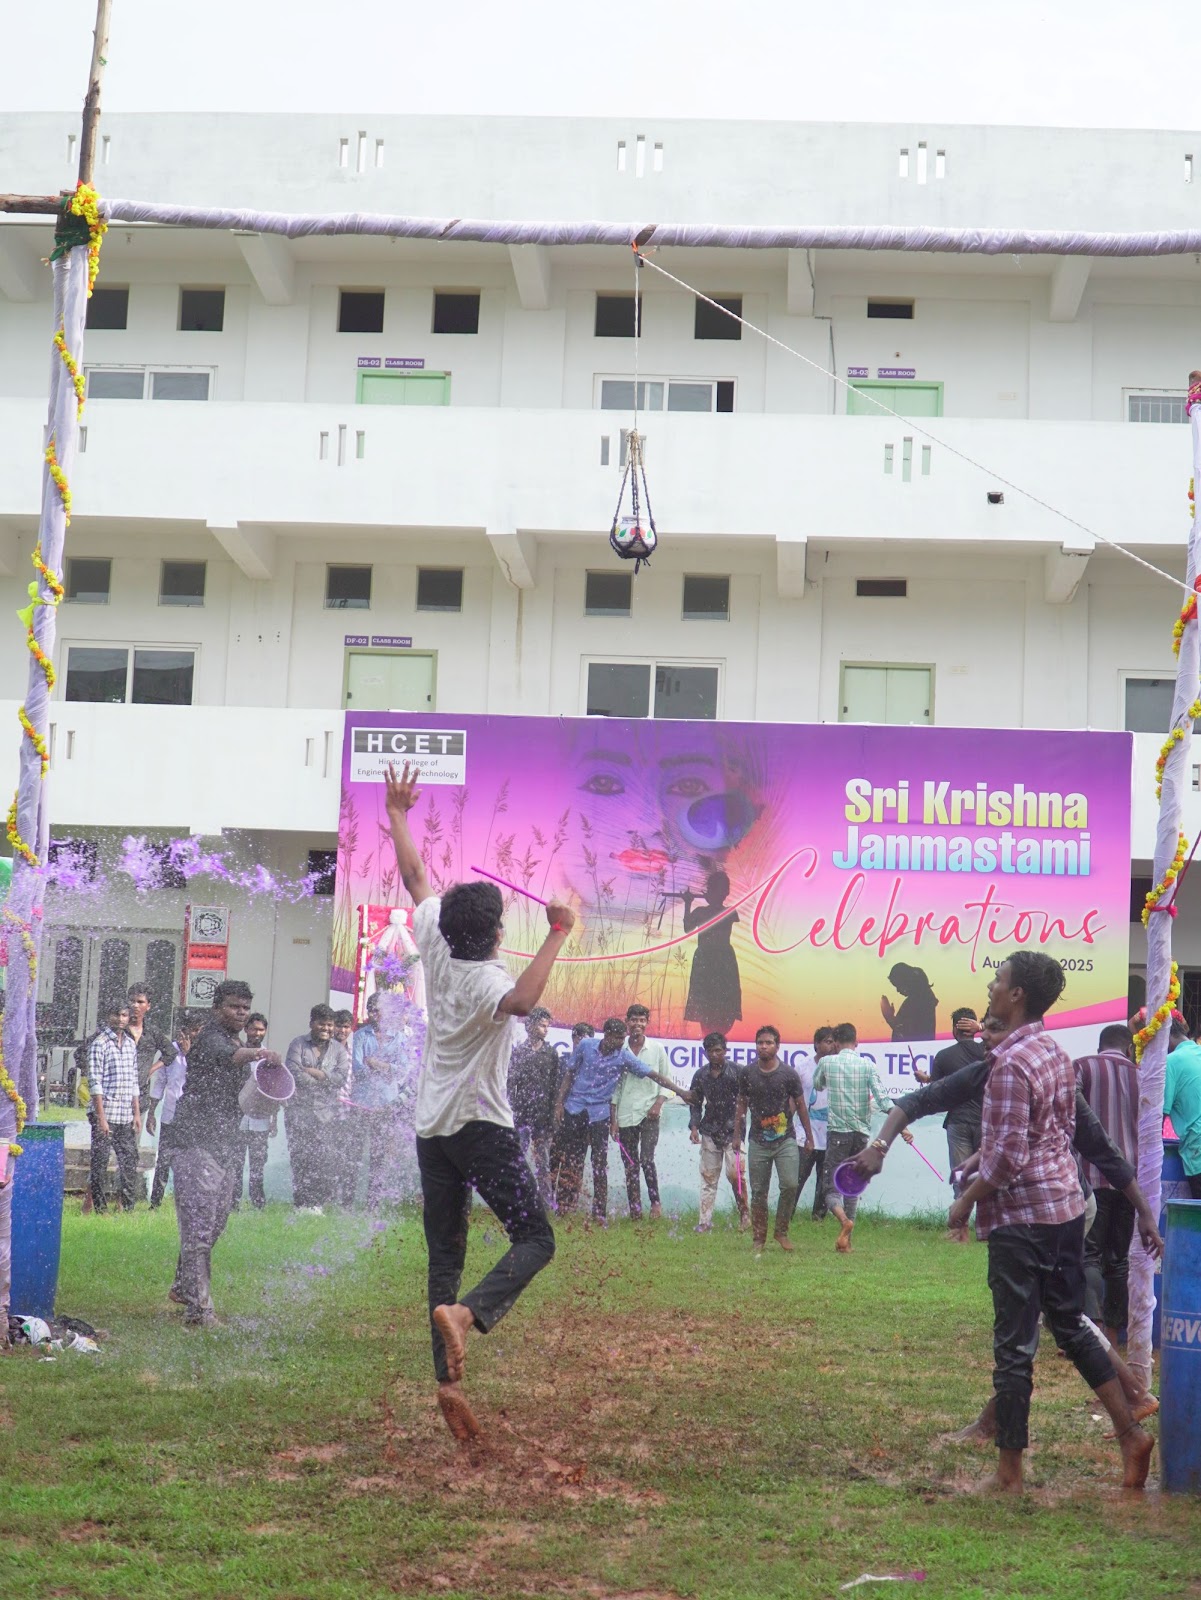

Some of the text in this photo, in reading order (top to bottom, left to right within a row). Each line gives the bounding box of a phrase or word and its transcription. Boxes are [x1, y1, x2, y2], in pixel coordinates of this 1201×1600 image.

[367, 733, 453, 754] HCET
[402, 759, 428, 767] Cllege
[844, 777, 1089, 829] Sri Krishna
[831, 825, 1092, 876] Janmastami
[752, 846, 1107, 973] Celebrations
[1060, 958, 1094, 972] 2025
